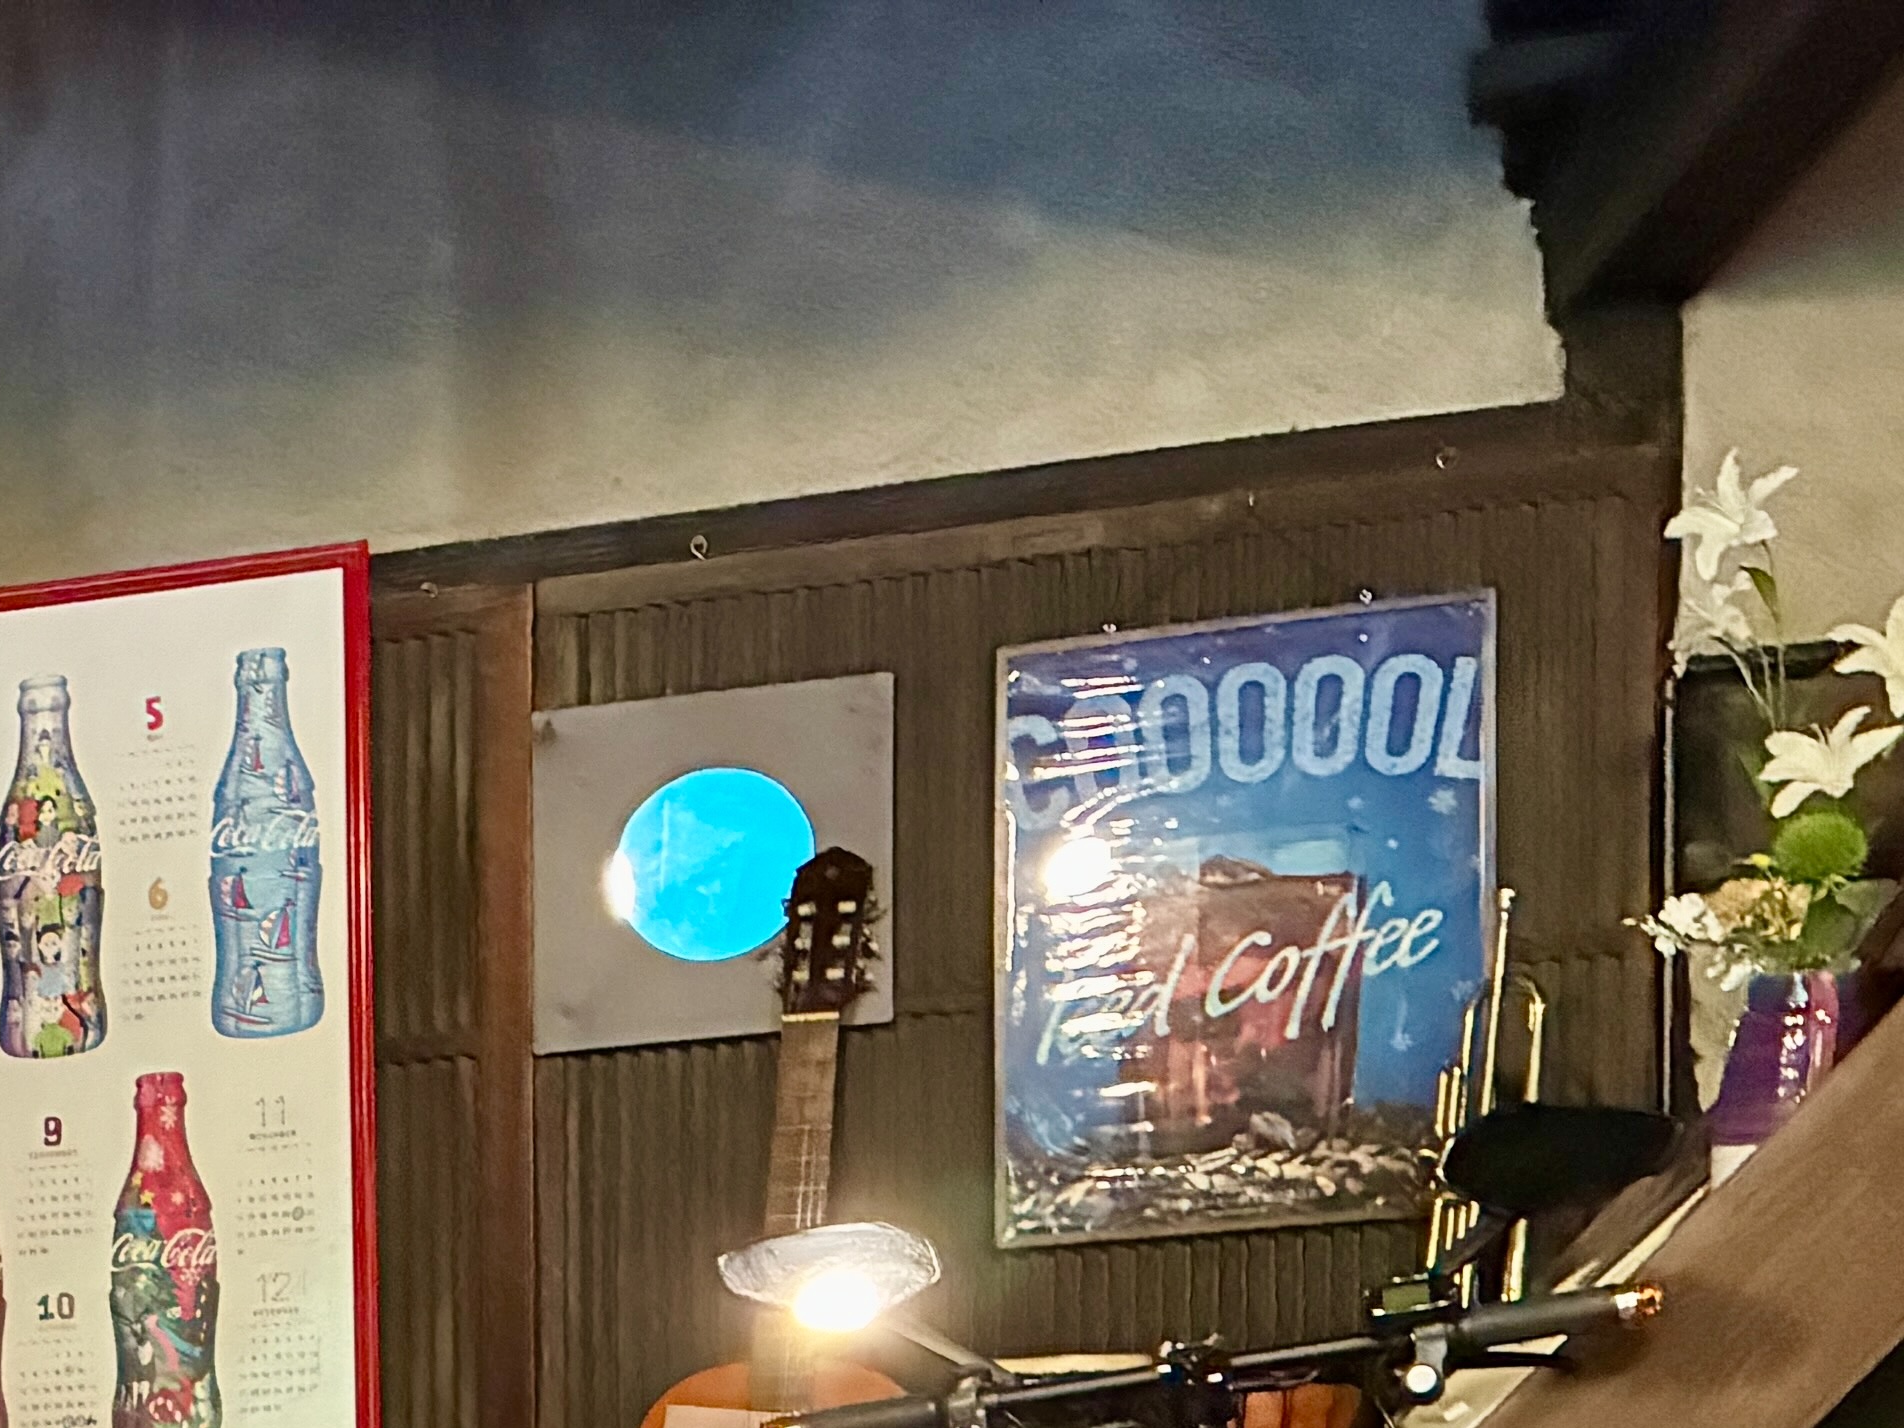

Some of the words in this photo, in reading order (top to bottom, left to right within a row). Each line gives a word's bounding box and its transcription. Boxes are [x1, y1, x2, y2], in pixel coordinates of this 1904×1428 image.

[146, 696, 163, 730] 5
[148, 876, 168, 910] 6
[1205, 880, 1444, 1041] Coffee
[44, 1116, 63, 1147] 9
[37, 1292, 76, 1321] 10
